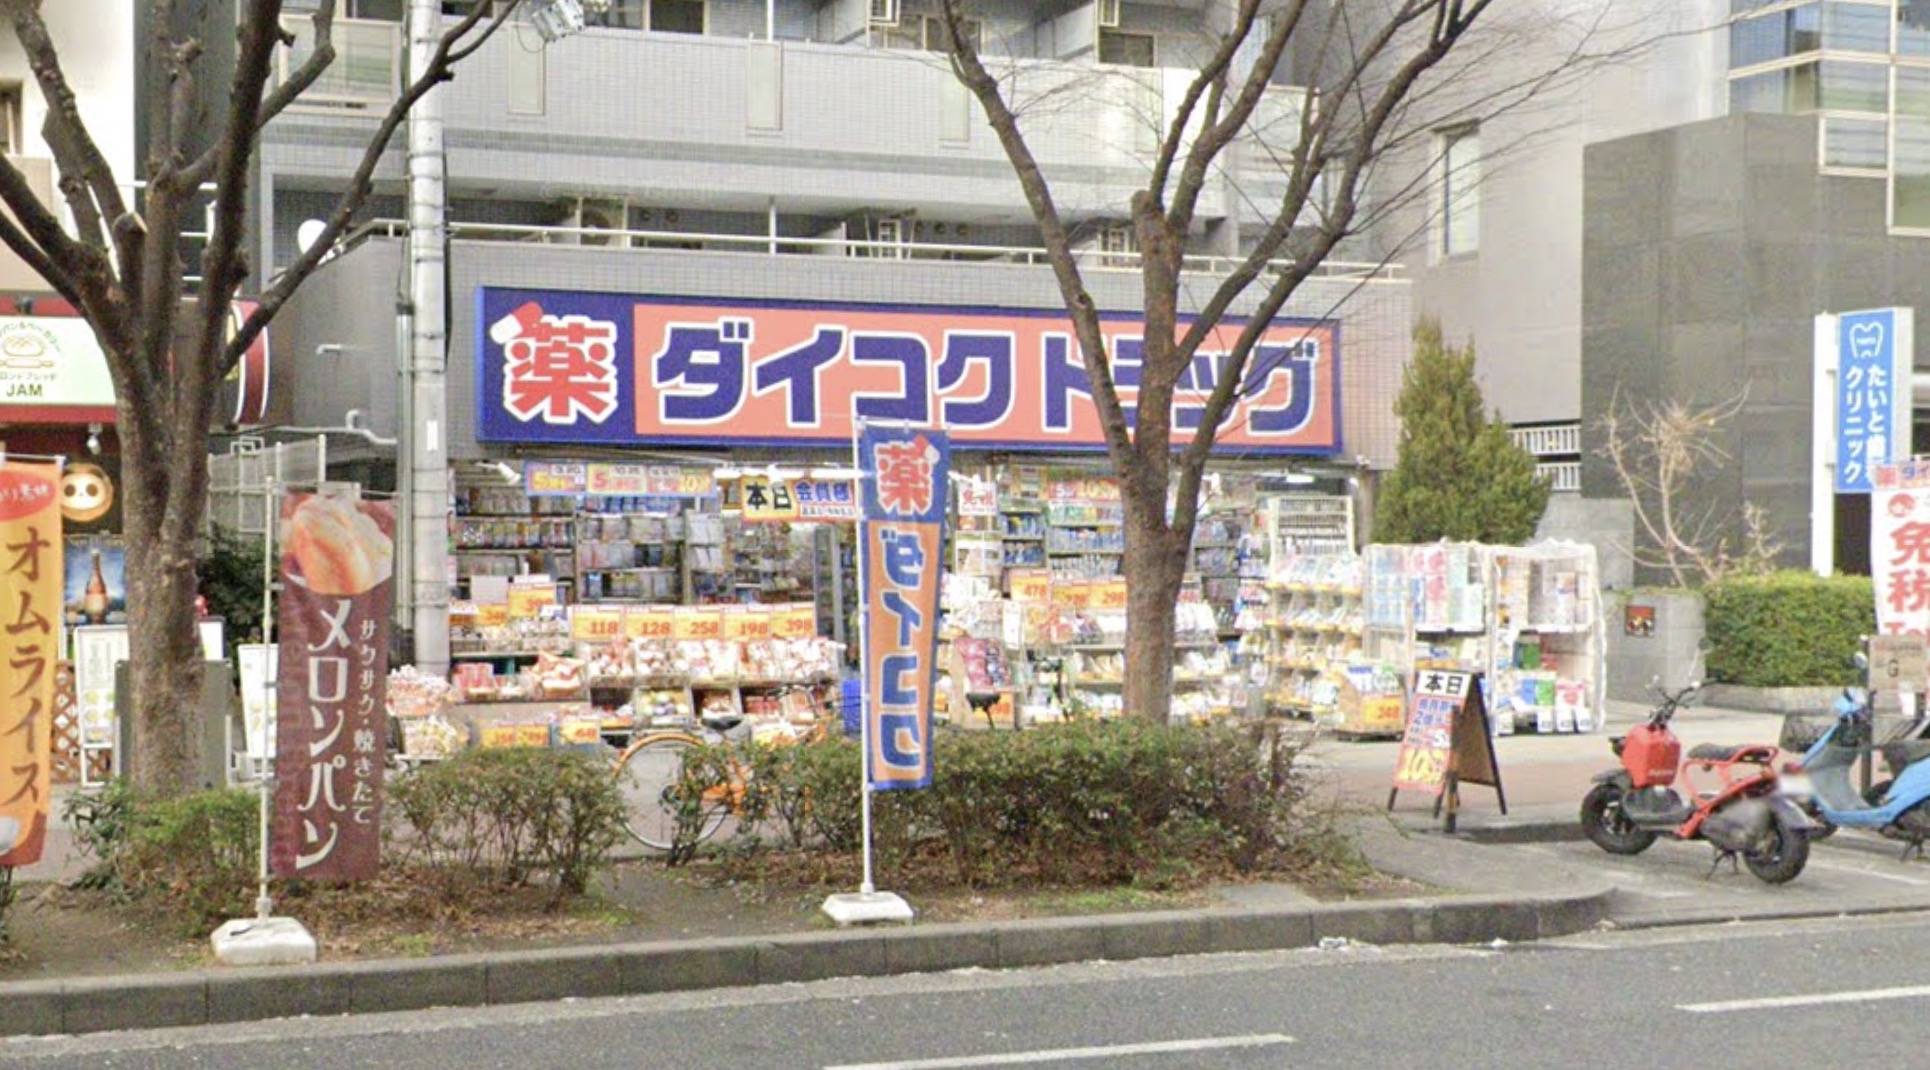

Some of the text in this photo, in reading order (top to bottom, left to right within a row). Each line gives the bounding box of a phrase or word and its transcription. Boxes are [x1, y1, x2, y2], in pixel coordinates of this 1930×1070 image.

[489, 302, 618, 424] 薬
[6, 384, 42, 397] JAM
[1843, 365, 1864, 485] クリニック
[744, 482, 792, 511] 本日
[590, 621, 618, 635] 118
[641, 621, 671, 636] 128
[690, 621, 719, 635] 258
[3, 526, 51, 804] オムライス
[1425, 673, 1463, 694] 本日
[295, 599, 352, 870] メロンパン
